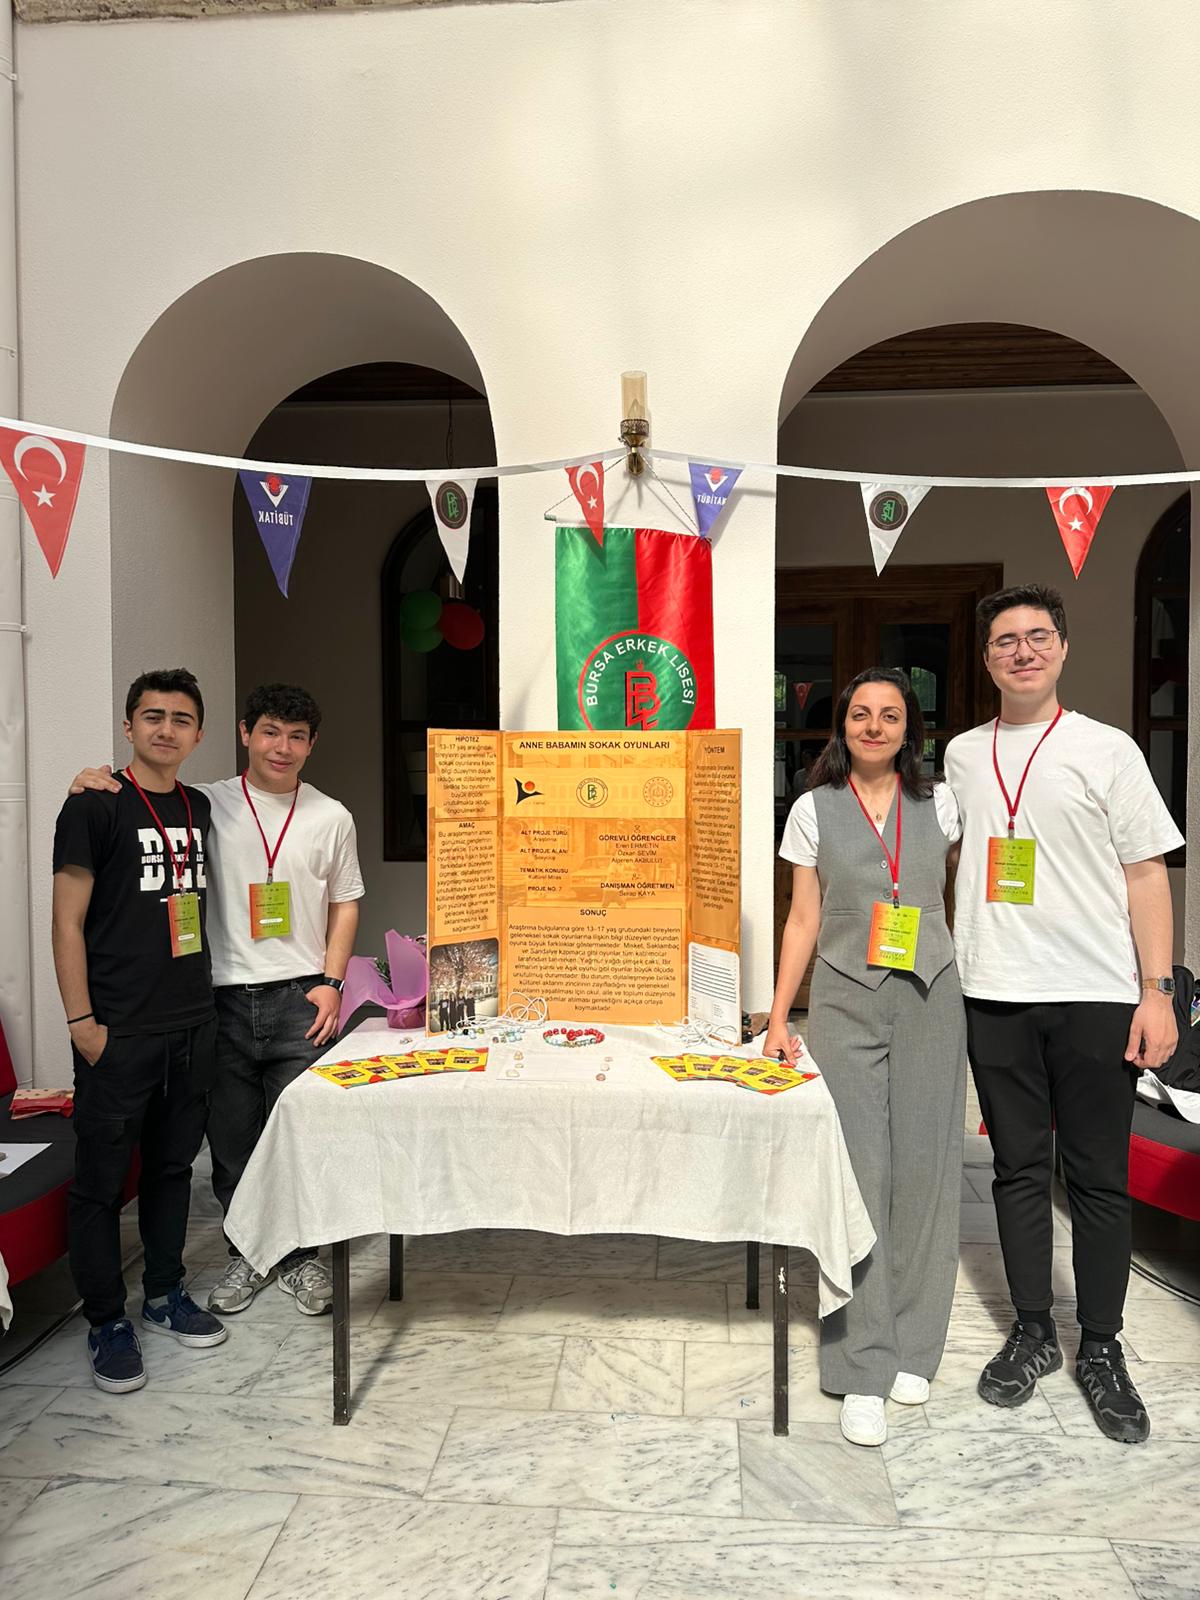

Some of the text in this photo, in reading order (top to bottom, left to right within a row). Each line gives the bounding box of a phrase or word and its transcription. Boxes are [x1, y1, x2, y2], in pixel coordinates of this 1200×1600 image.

[697, 493, 727, 505] TÜBİTAK
[586, 638, 695, 706] BURSA ERKEK LİSESİ
[519, 741, 670, 749] ANNE BABAMIN SOKAK OYUNLARI
[141, 853, 164, 864] BURSA
[580, 909, 607, 917] SONUÇ
